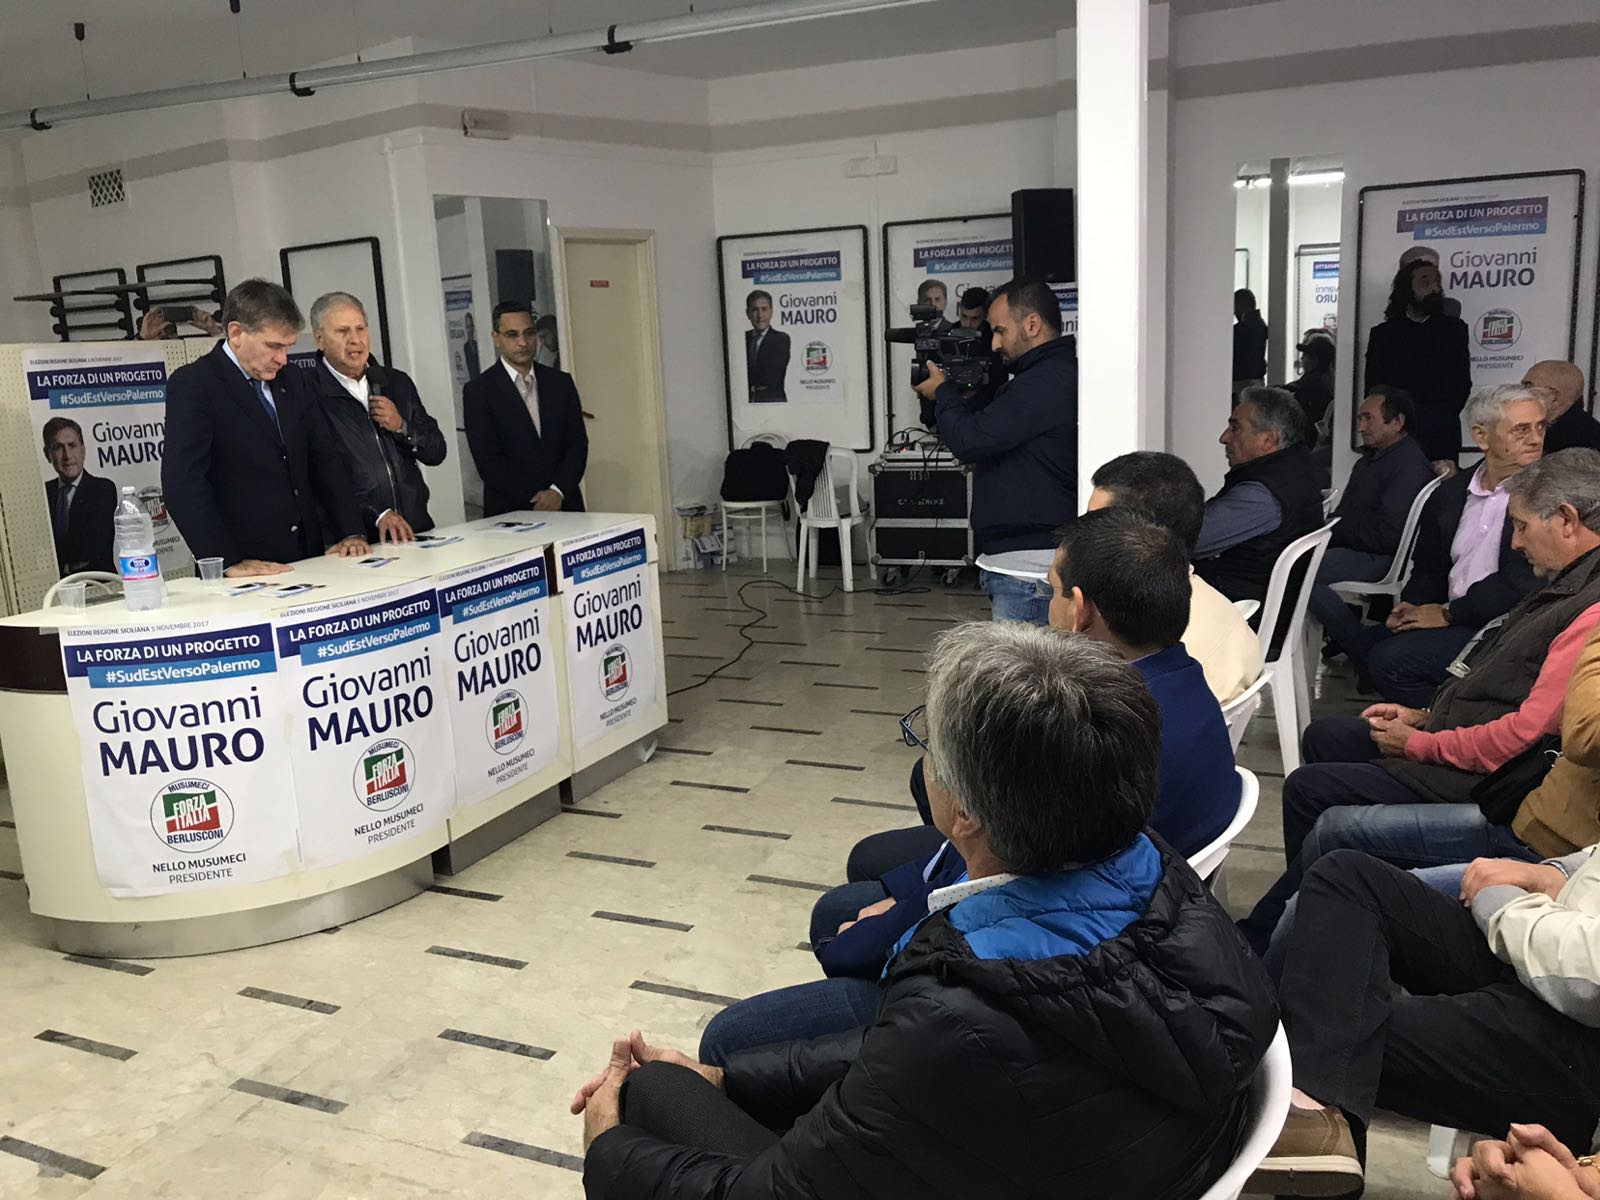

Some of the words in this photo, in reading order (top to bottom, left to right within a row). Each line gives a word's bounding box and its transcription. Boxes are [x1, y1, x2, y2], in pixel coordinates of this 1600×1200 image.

[1406, 213, 1418, 222] LA
[1420, 211, 1454, 220] FORZA
[1456, 210, 1467, 219] DI
[1470, 208, 1484, 218] UN
[1486, 204, 1542, 216] PROGETTO
[747, 262, 756, 270] LA
[756, 260, 779, 270] FORZA
[780, 260, 787, 268] DI
[788, 259, 798, 267] UN
[800, 256, 838, 266] PROGETTO
[930, 249, 956, 258] FORZA
[957, 248, 965, 256] DI
[966, 247, 978, 255] UN
[1450, 246, 1537, 268] Giovanni
[1449, 268, 1535, 290] MAURO
[780, 291, 837, 308] Giovanni
[781, 308, 838, 326] MAURO
[36, 376, 51, 386] LA
[53, 374, 86, 386] FORZA
[88, 373, 98, 384] DI
[100, 372, 114, 382] UN
[115, 370, 162, 382] PROGETTO
[60, 390, 164, 405] #SudEstVersoPalermo
[567, 556, 576, 566] LA
[576, 550, 596, 563] FORZA
[596, 547, 604, 557] DI
[604, 544, 612, 554] UN
[613, 536, 642, 552] PROGETTO
[445, 592, 456, 603] LA
[457, 584, 480, 600] FORZA
[483, 581, 492, 592] DI
[492, 578, 503, 589] UN
[504, 566, 540, 586] PROGETTO
[573, 573, 642, 619] Giovanni
[280, 608, 306, 618] ELEZIONI
[306, 604, 331, 614] REGIONE
[332, 599, 356, 608] SICILIANA
[462, 585, 540, 618] #SudEstVersoPalermo
[94, 628, 119, 636] REGIONE
[120, 626, 150, 634] SICILIANA
[156, 622, 192, 631] NOVEMBRE
[193, 620, 209, 628] 2017
[290, 629, 306, 642] LA
[308, 620, 349, 638] FORZA
[351, 616, 363, 630] DI
[365, 614, 381, 626] UN
[383, 600, 430, 622] PROGETTO
[576, 604, 643, 652] MAURO
[317, 622, 430, 658] #SudEstVersoPalermo
[454, 608, 540, 664] Giovanni
[76, 650, 94, 662] LA
[96, 647, 142, 662] FORZA
[144, 645, 159, 658] DI
[162, 643, 182, 656] UN
[186, 634, 260, 654] PROGETTO
[106, 659, 260, 684] #SudEstVersoPalermo
[302, 647, 432, 708] Giovanni
[457, 642, 542, 702] MAURO
[93, 686, 262, 734] Giovanni
[308, 685, 434, 751] MAURO
[100, 728, 264, 776] MAURO
[368, 741, 400, 756] MUSUMECI
[372, 752, 397, 777] FORZA
[488, 762, 506, 778] NELLO
[506, 748, 535, 768] MUSUMECI
[496, 762, 528, 784] PRESIDENTE
[168, 781, 210, 792] MUSUMECI
[374, 766, 400, 791] ITALIA
[173, 794, 208, 816] FORZA
[366, 784, 410, 806] BERLUSCONI
[175, 808, 211, 830] ITALIA
[354, 820, 382, 836] NELLO
[384, 803, 424, 826] MUSUMECI
[167, 829, 224, 844] BERLUSCONI
[368, 818, 416, 844] PRESIDENTE
[152, 861, 186, 872] NELLO
[188, 853, 246, 869] MUSUMECI
[169, 868, 233, 884] PRESIDENTE
